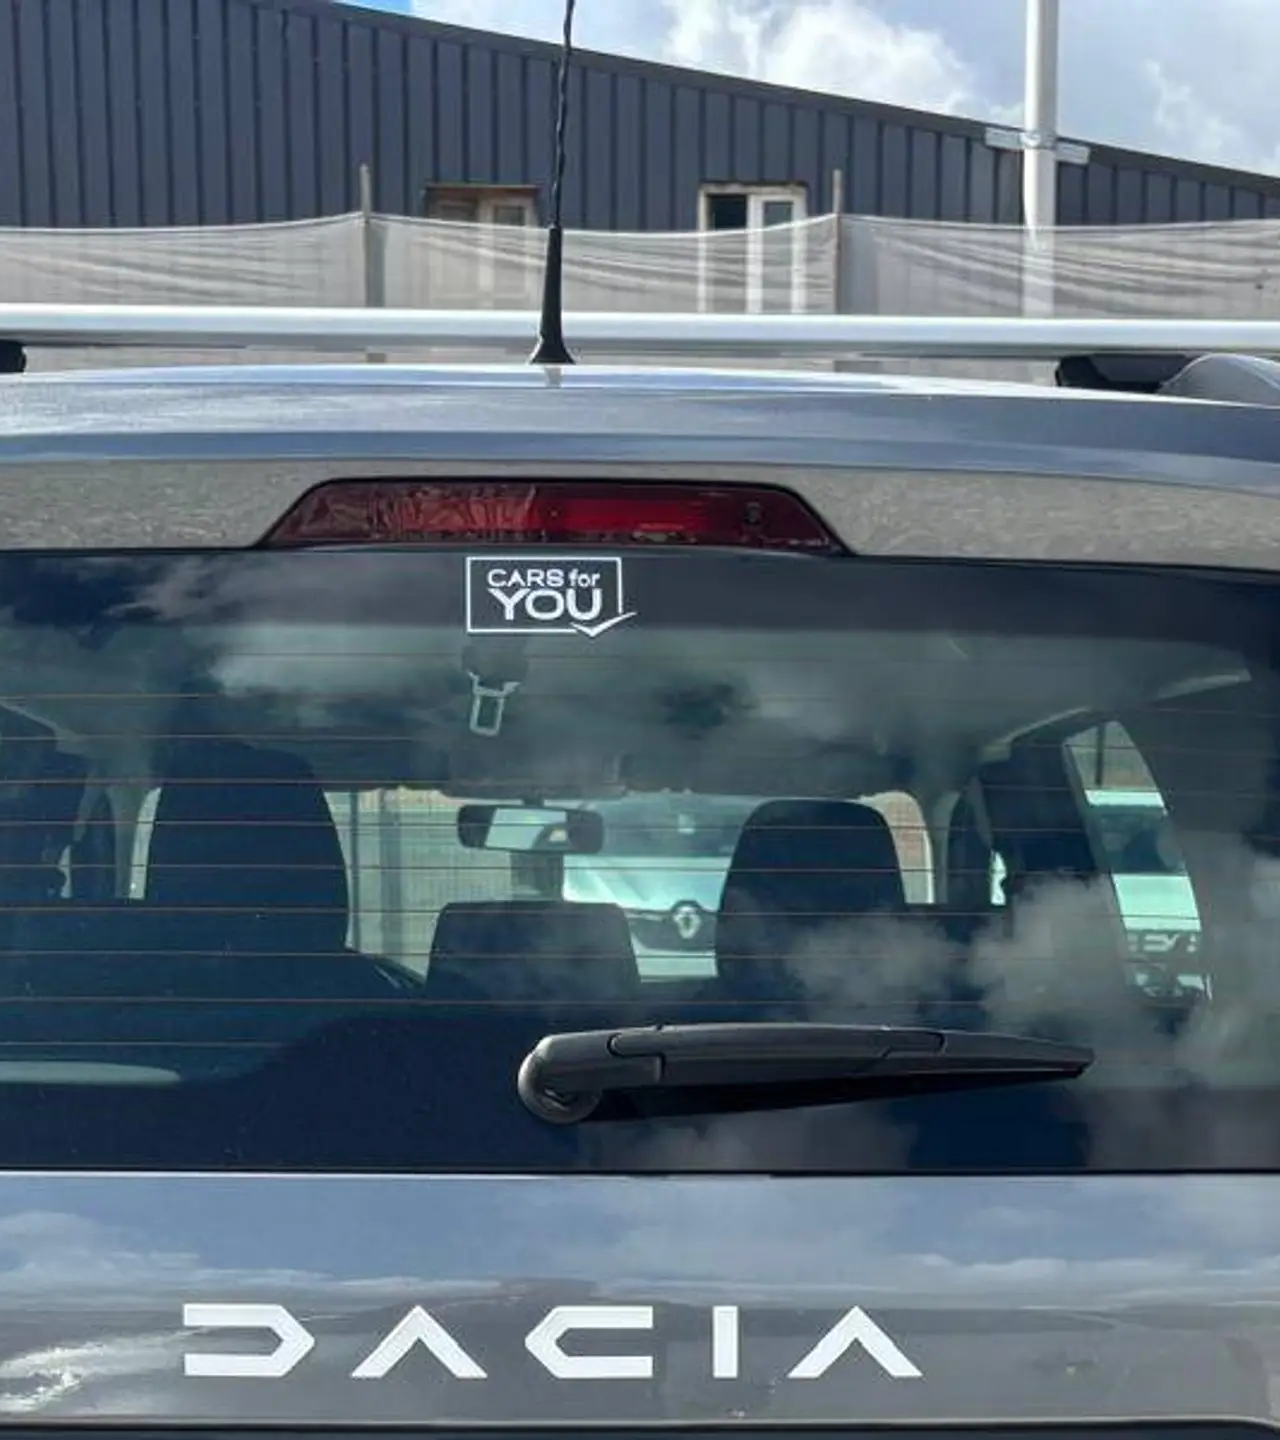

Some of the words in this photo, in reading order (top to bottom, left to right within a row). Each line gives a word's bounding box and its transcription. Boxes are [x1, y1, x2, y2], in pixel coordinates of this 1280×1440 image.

[486, 569, 564, 587] CARS
[569, 569, 601, 587] for
[487, 588, 603, 620] YOU
[183, 1304, 923, 1378] DACIA
